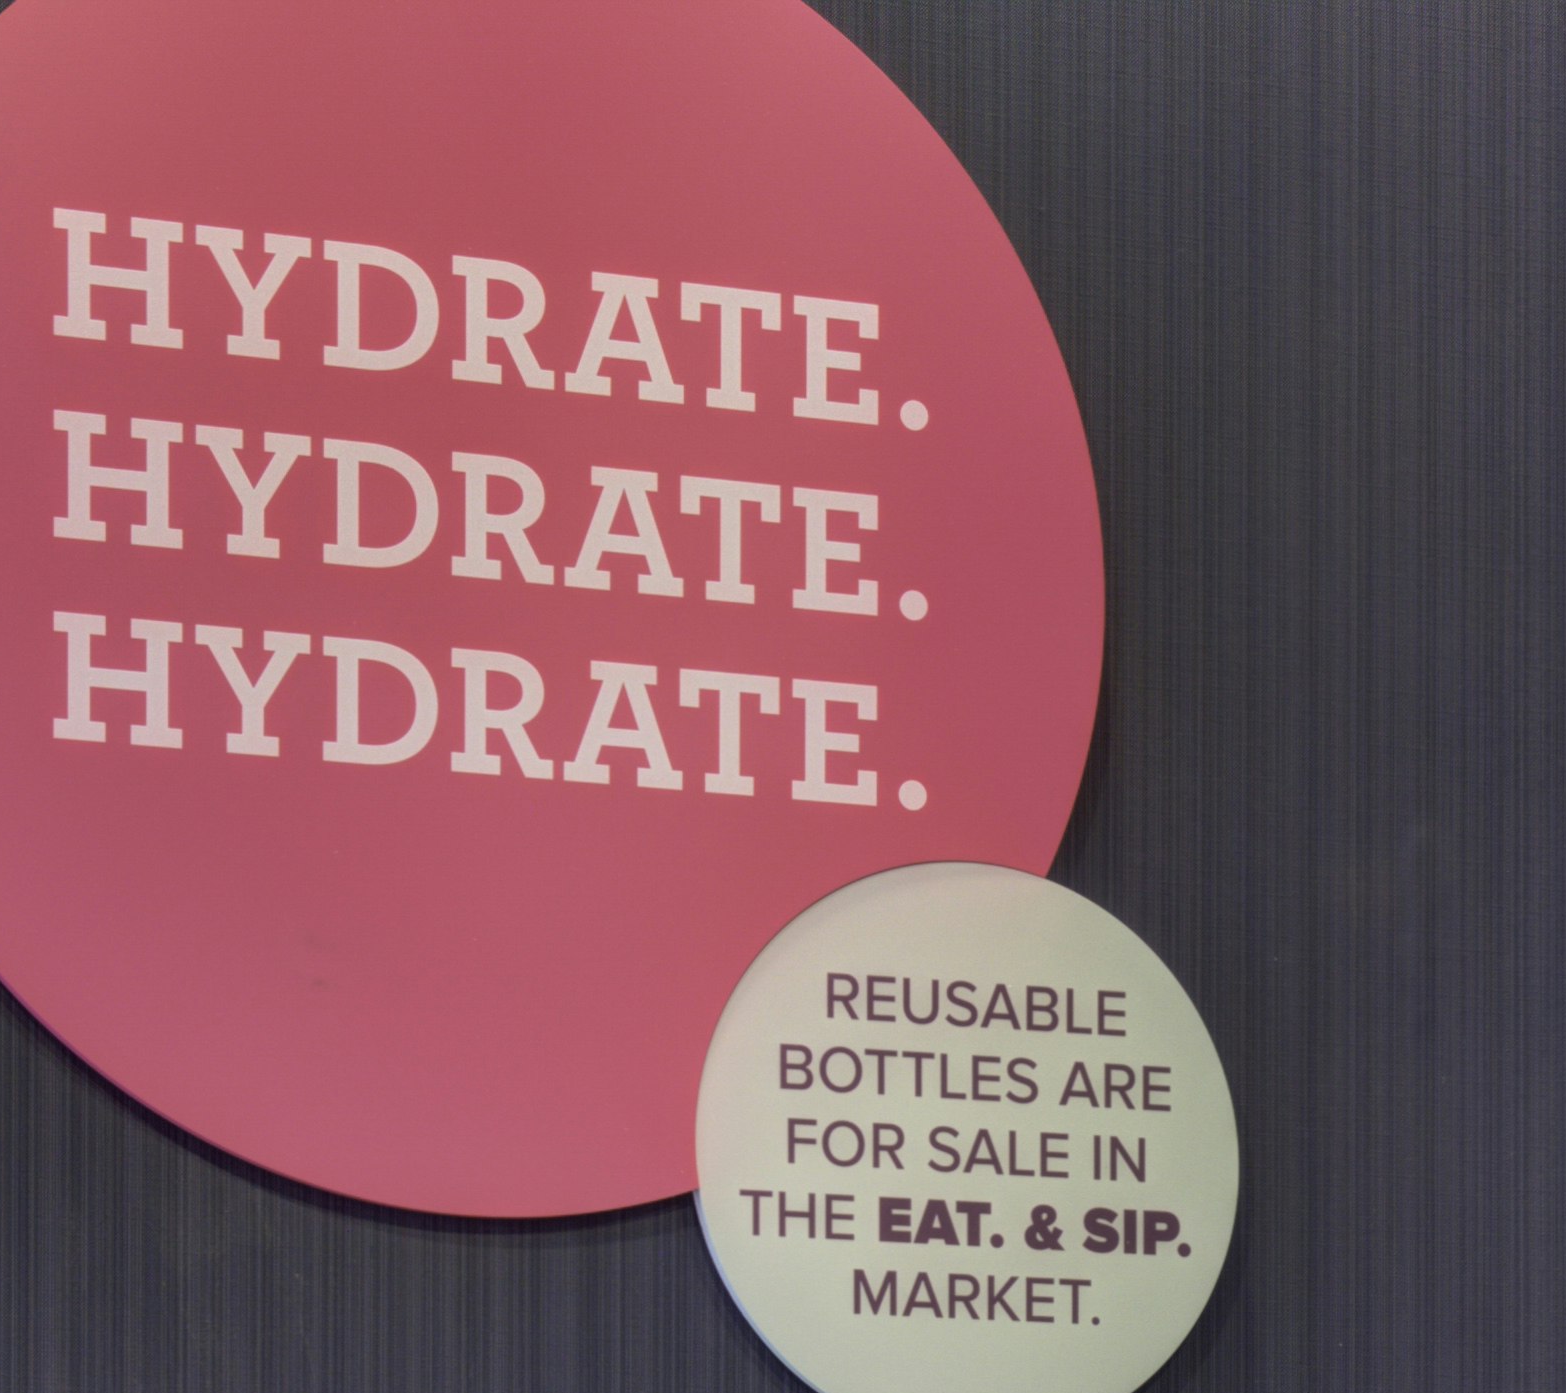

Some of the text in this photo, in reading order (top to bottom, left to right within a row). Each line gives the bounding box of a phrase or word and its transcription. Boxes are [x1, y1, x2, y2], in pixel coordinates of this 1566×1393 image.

[52, 206, 930, 431] HYDRATE.
[52, 408, 930, 621] HYDRATE.
[52, 610, 930, 811] HYDRATE.
[826, 972, 1128, 1038] REUSABLE
[779, 1043, 1172, 1113] BOTTLES ARE
[786, 1117, 1147, 1184] FOR SALE IN
[739, 1189, 1193, 1258] THE EAT. & SIP.
[852, 1268, 1102, 1326] MARKET.
